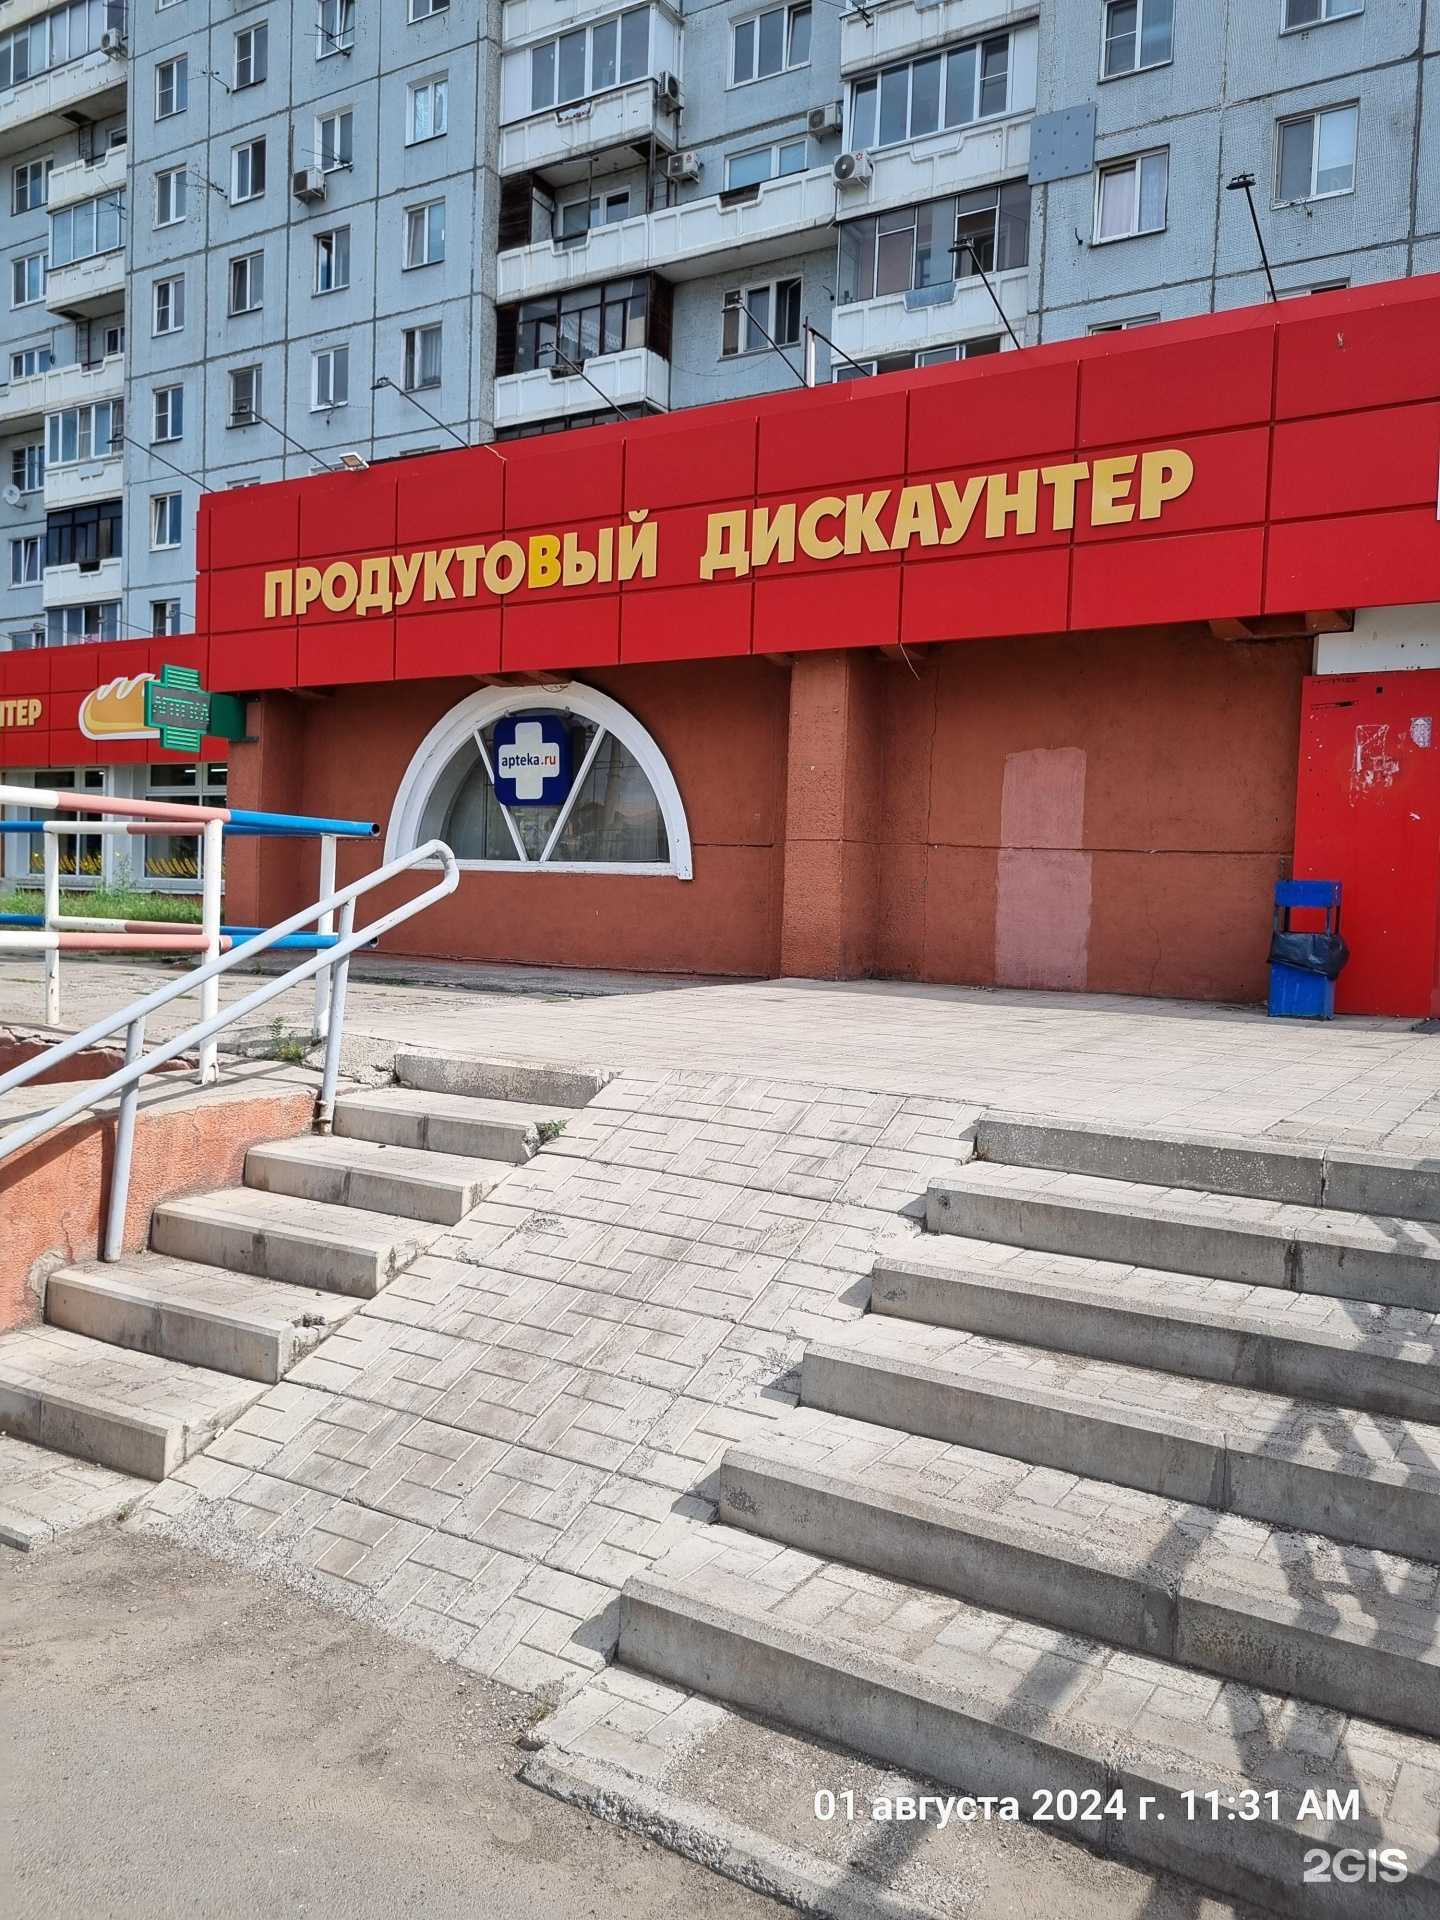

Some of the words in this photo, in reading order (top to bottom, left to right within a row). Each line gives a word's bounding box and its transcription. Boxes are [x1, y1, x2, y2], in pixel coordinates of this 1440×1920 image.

[264, 508, 658, 618] ПРОДУКТОВЫЙ
[699, 448, 1194, 580] ДИСКАУНТЕР
[501, 753, 556, 769] apteka.ru
